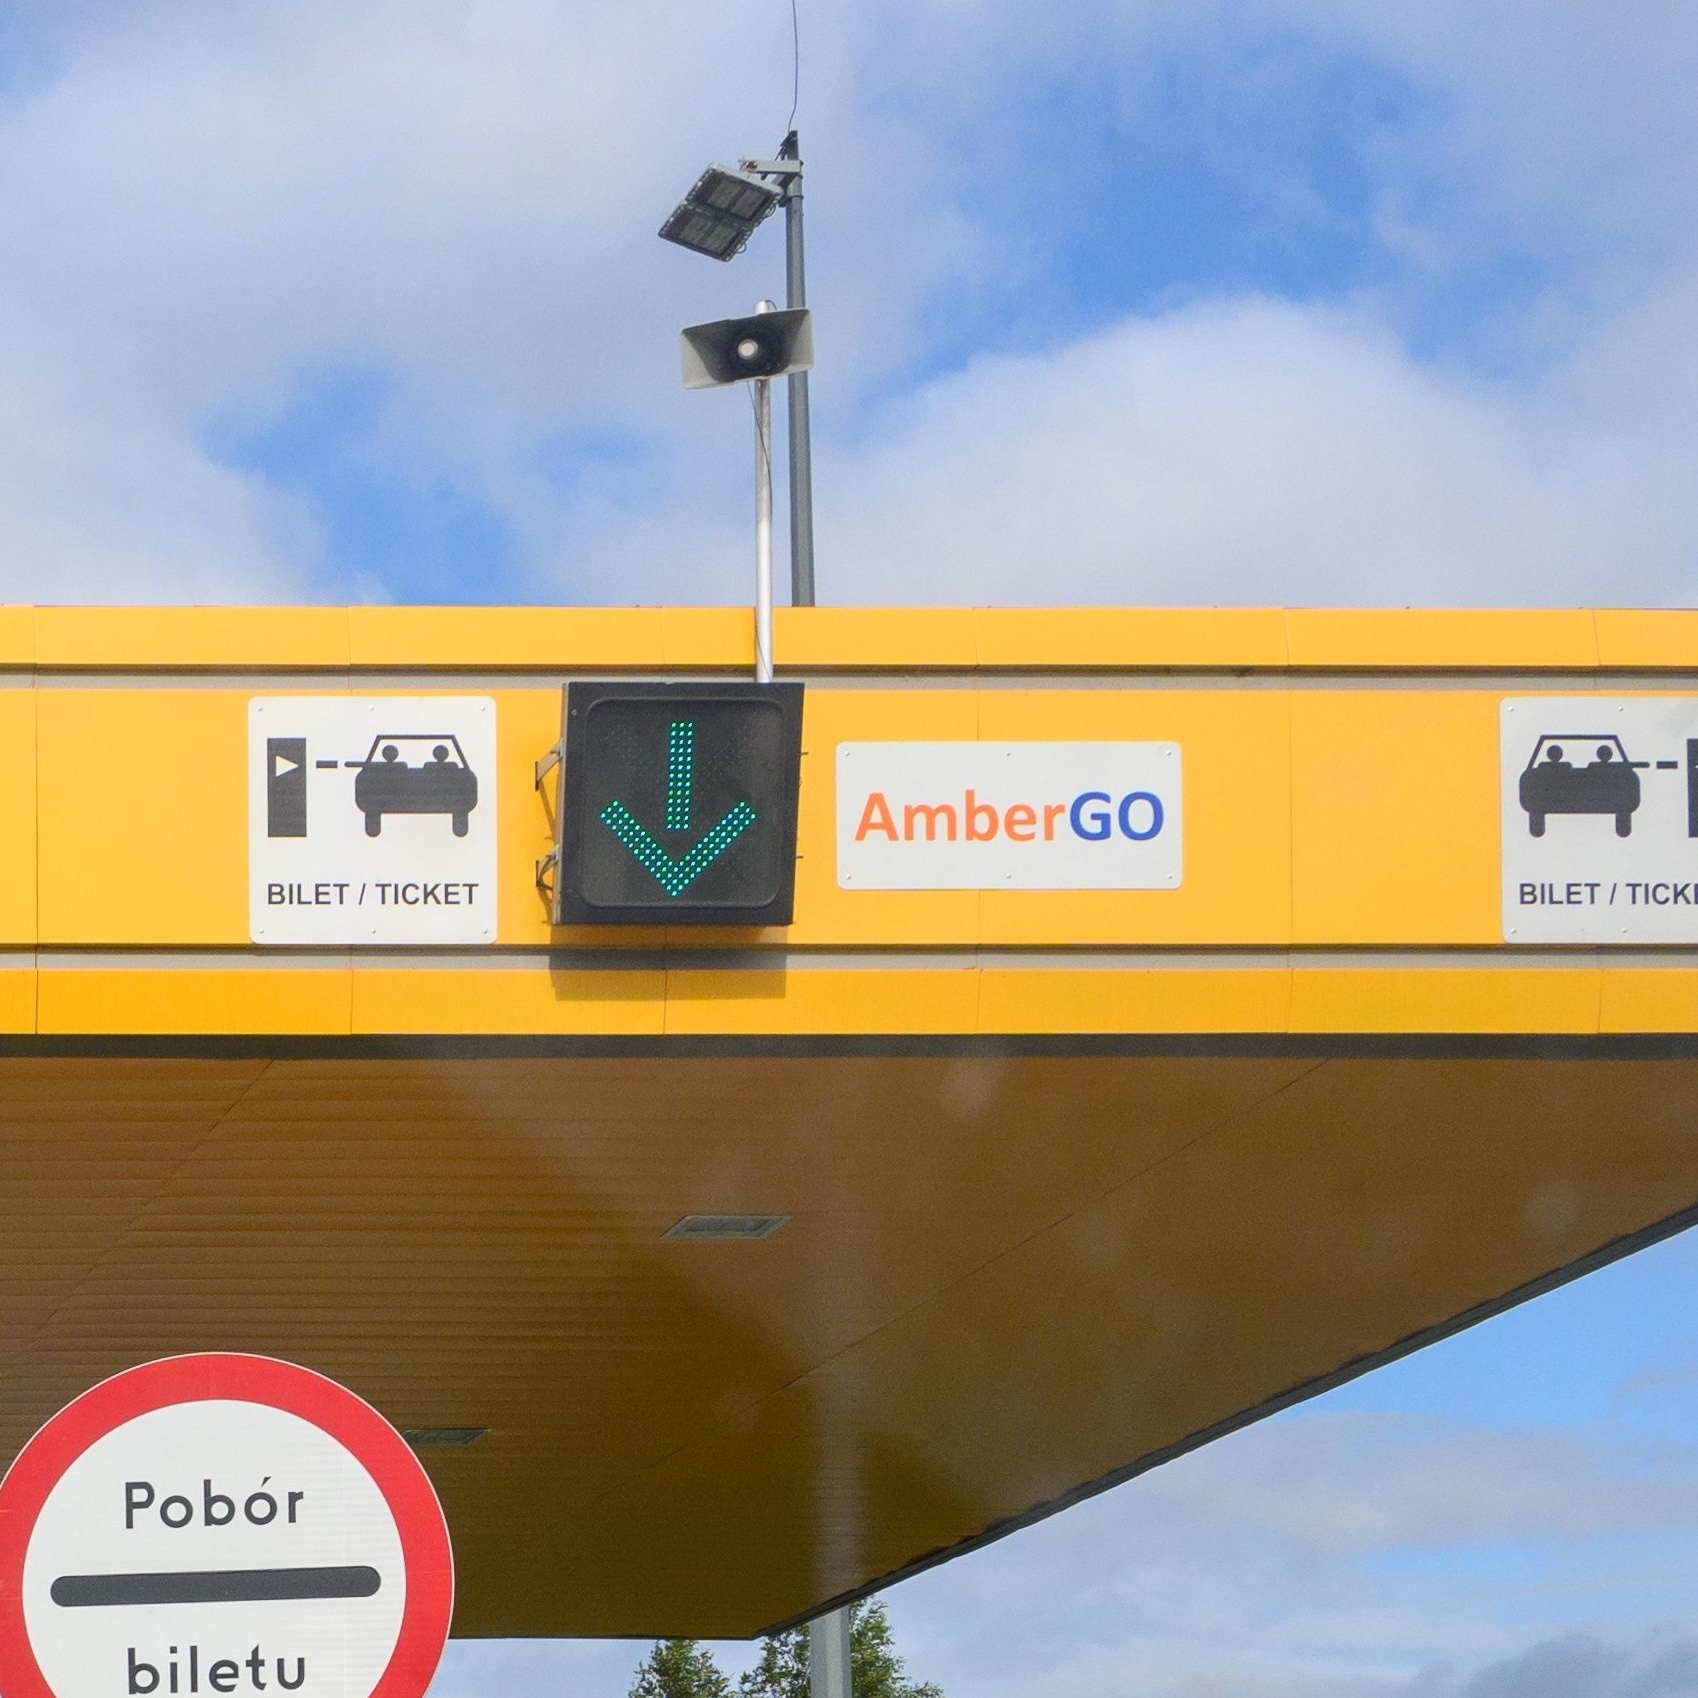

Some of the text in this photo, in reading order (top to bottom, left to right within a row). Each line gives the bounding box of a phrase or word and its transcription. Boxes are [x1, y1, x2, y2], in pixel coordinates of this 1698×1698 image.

[854, 789, 1164, 844] AmberGO
[268, 883, 350, 905] BILET
[375, 883, 479, 905] TICKET
[1519, 883, 1601, 905] BILET
[1625, 883, 1698, 905] TICKE
[125, 1476, 304, 1529] Pobór
[127, 1645, 305, 1695] biletu
